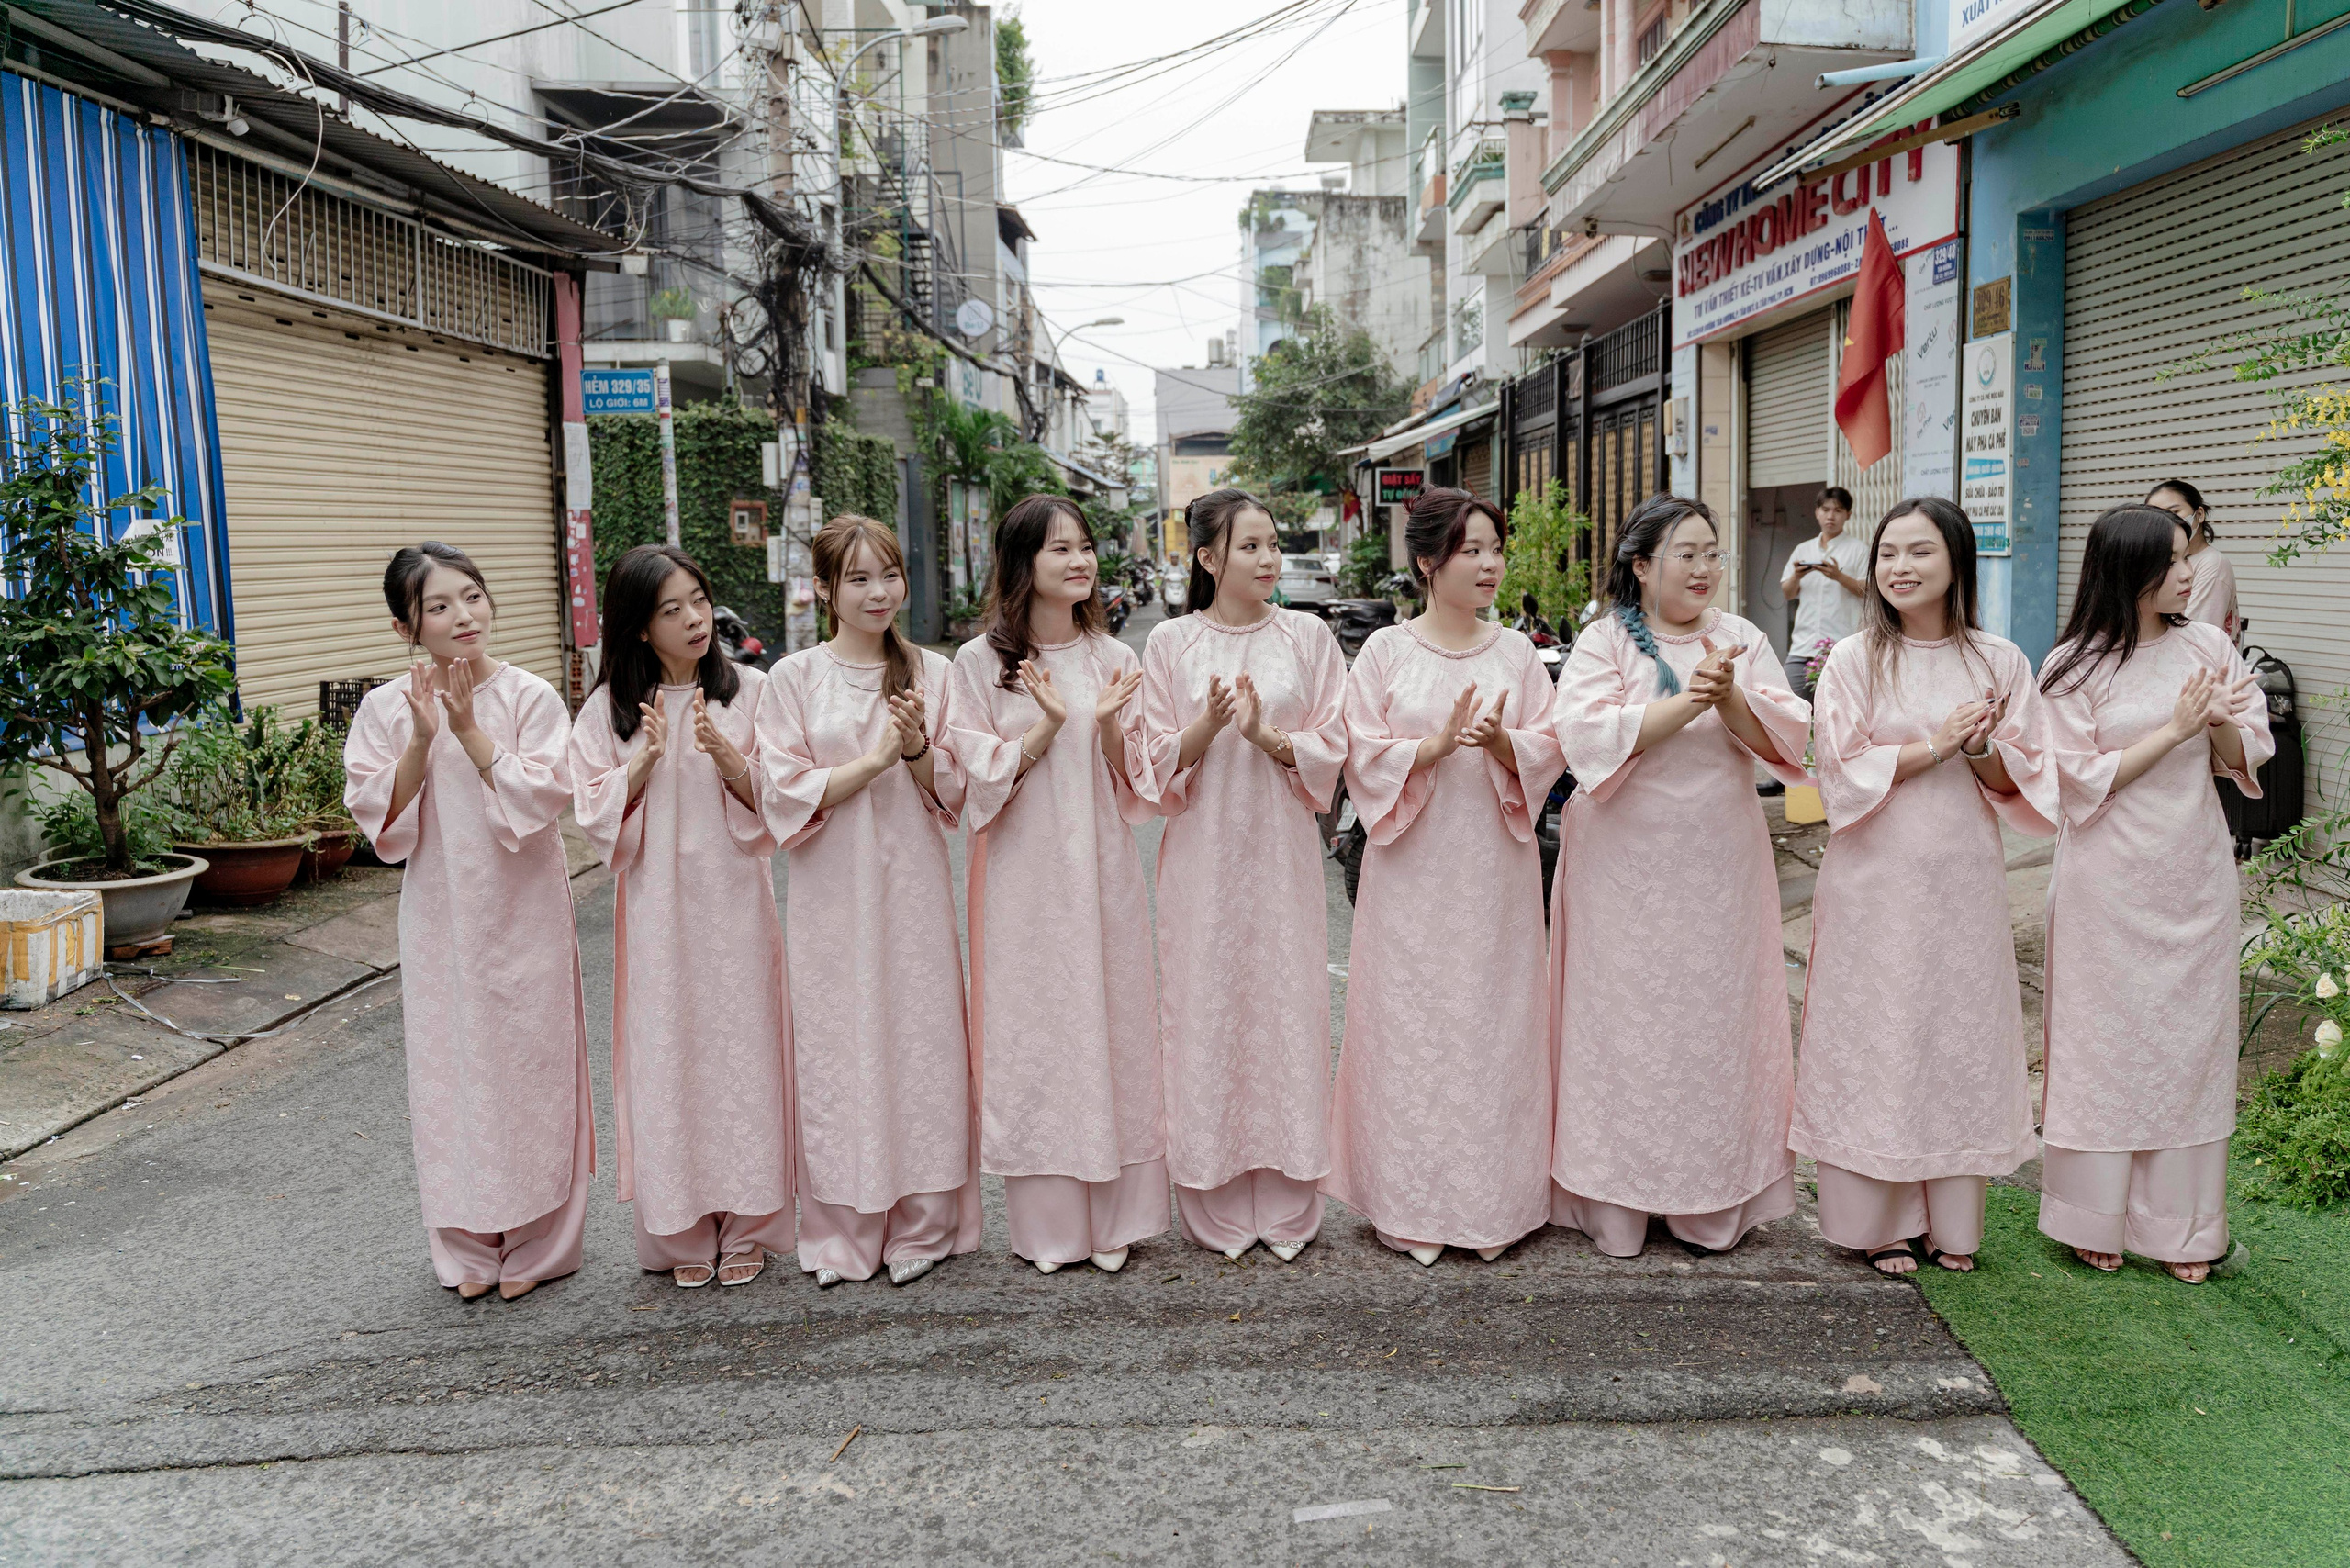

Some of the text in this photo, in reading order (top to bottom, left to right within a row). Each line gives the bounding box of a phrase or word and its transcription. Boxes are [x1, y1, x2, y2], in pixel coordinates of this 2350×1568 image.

[1719, 280, 1739, 308] THIẾT
[585, 375, 609, 394] HẺM
[611, 378, 651, 395] 329/35
[589, 397, 648, 409] LỘ GIỚI: 6M
[1971, 402, 2001, 427] CHUYÊN BÁN
[1966, 432, 1977, 453] MÁY
[1977, 434, 1987, 452] PHA
[1996, 427, 2006, 449] PHÊ
